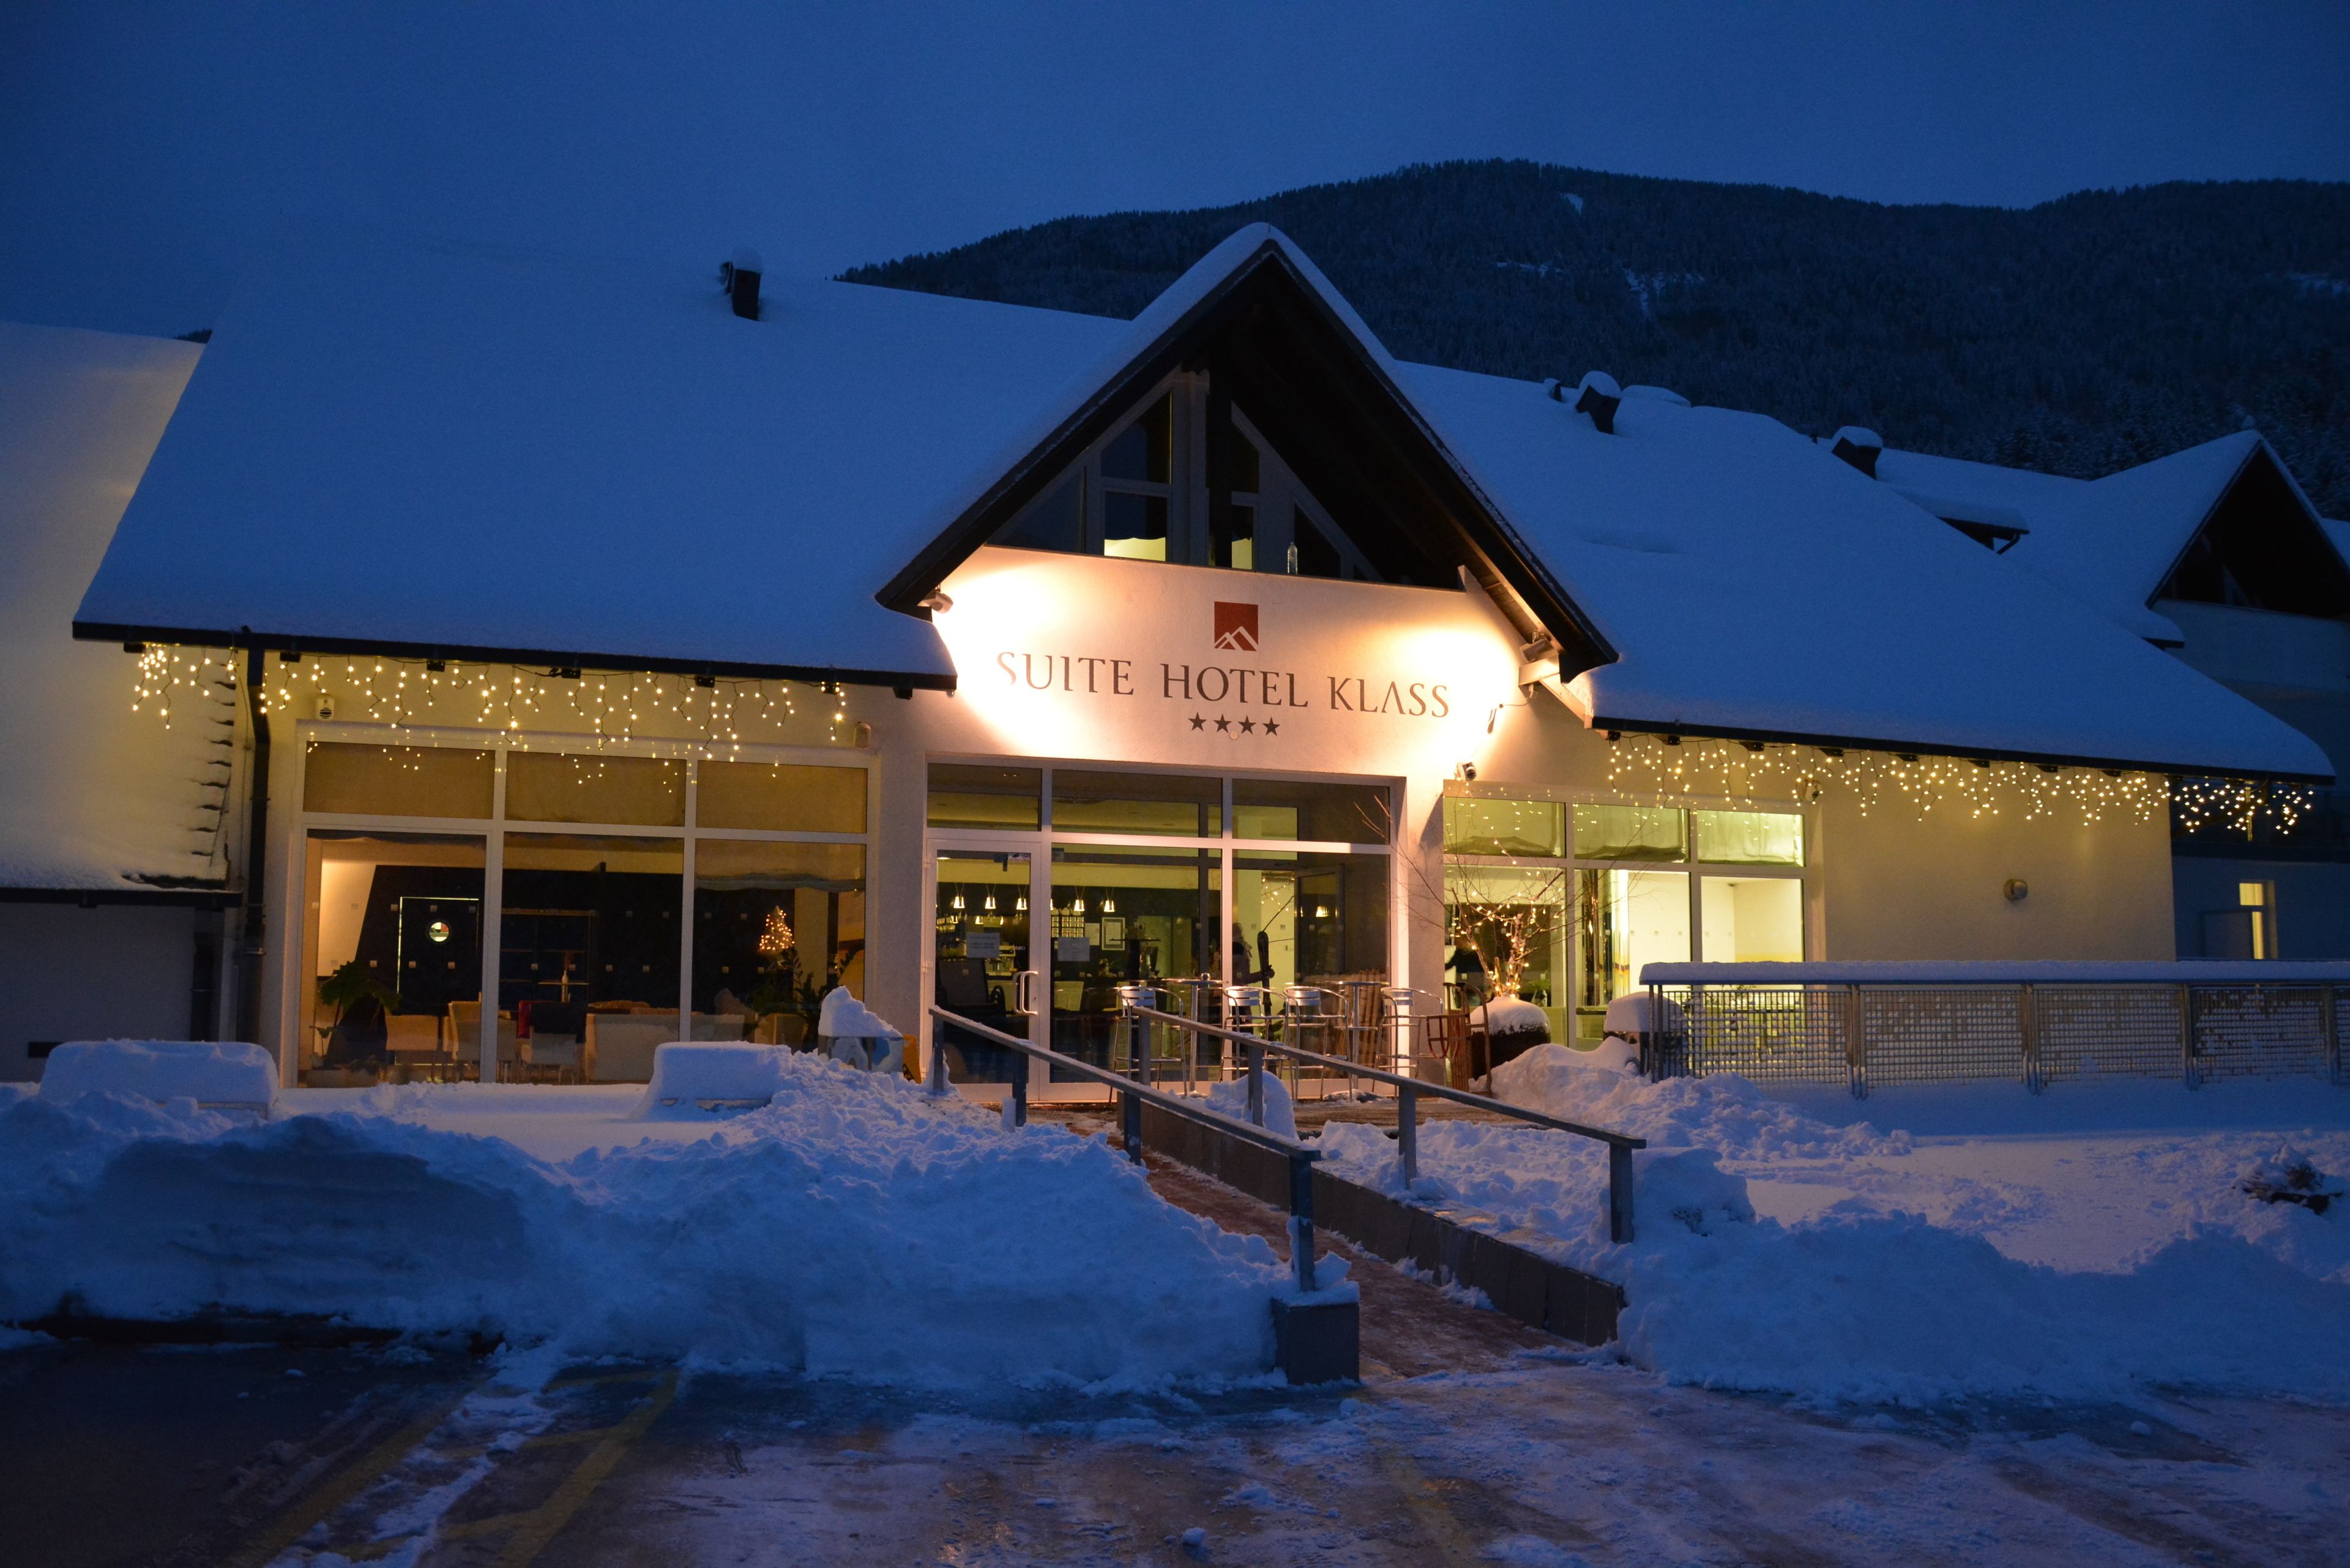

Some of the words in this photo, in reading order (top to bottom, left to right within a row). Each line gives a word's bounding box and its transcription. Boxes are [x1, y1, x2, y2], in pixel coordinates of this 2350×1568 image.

[996, 651, 1135, 696] SUITE
[1160, 663, 1308, 708] HOTEL
[1327, 676, 1449, 718] KLASS
